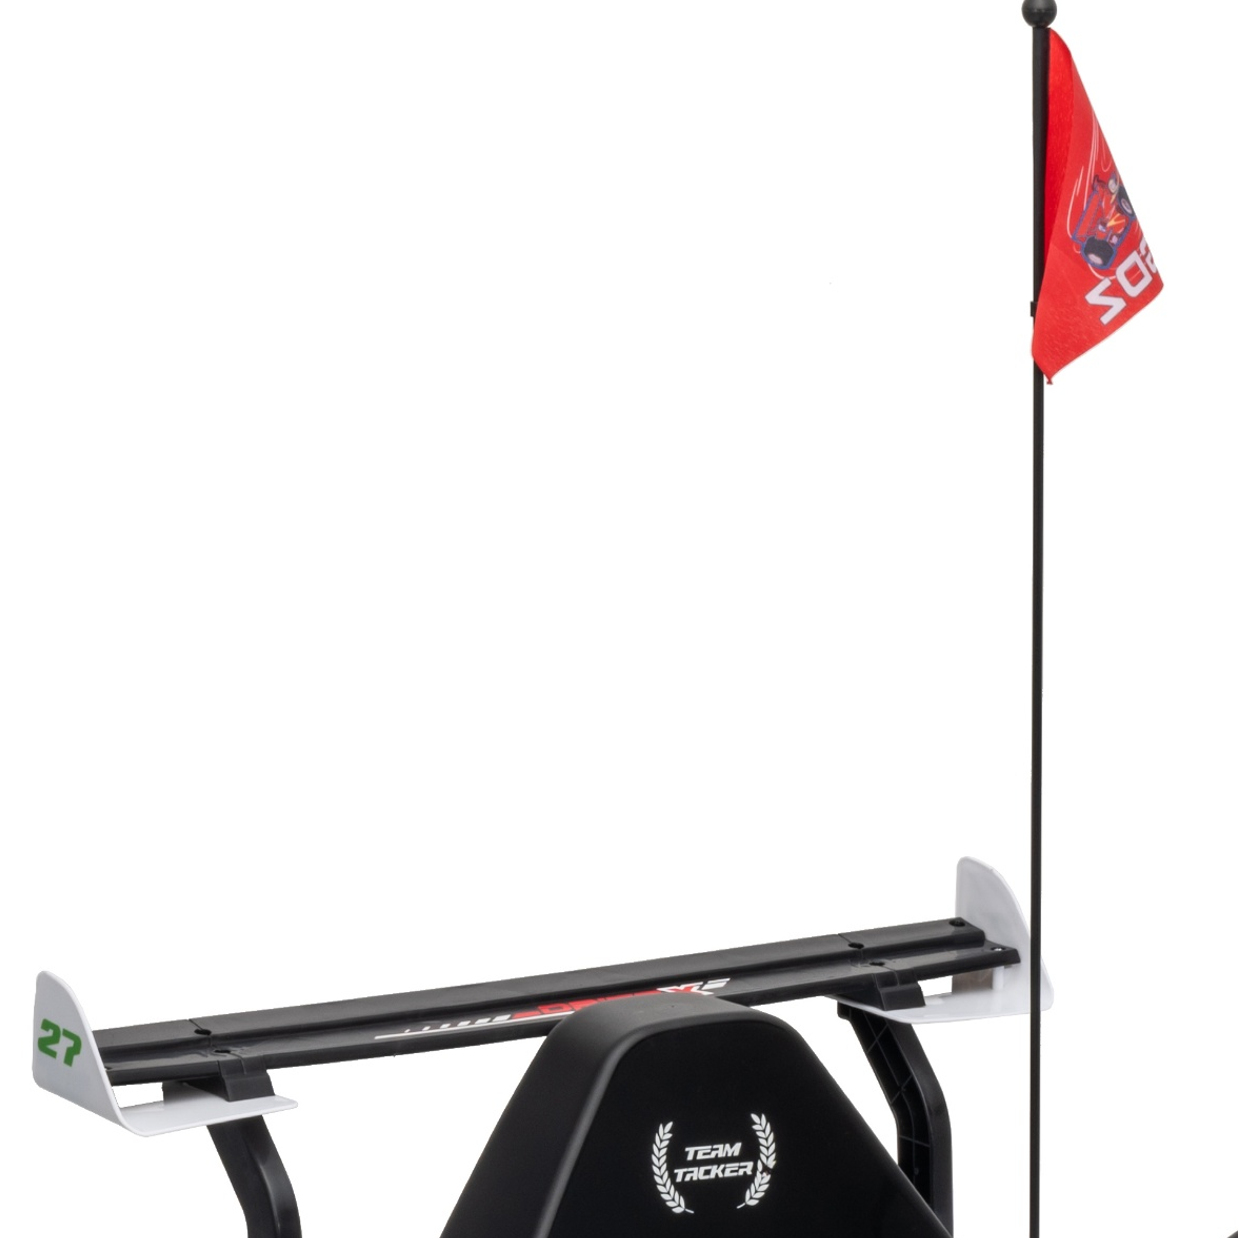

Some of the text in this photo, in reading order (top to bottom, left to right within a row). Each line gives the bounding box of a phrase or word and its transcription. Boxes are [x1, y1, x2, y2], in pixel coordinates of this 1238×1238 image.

[38, 1018, 82, 1067] 27
[685, 1142, 742, 1161] TEAM
[674, 1161, 754, 1182] TACKER
